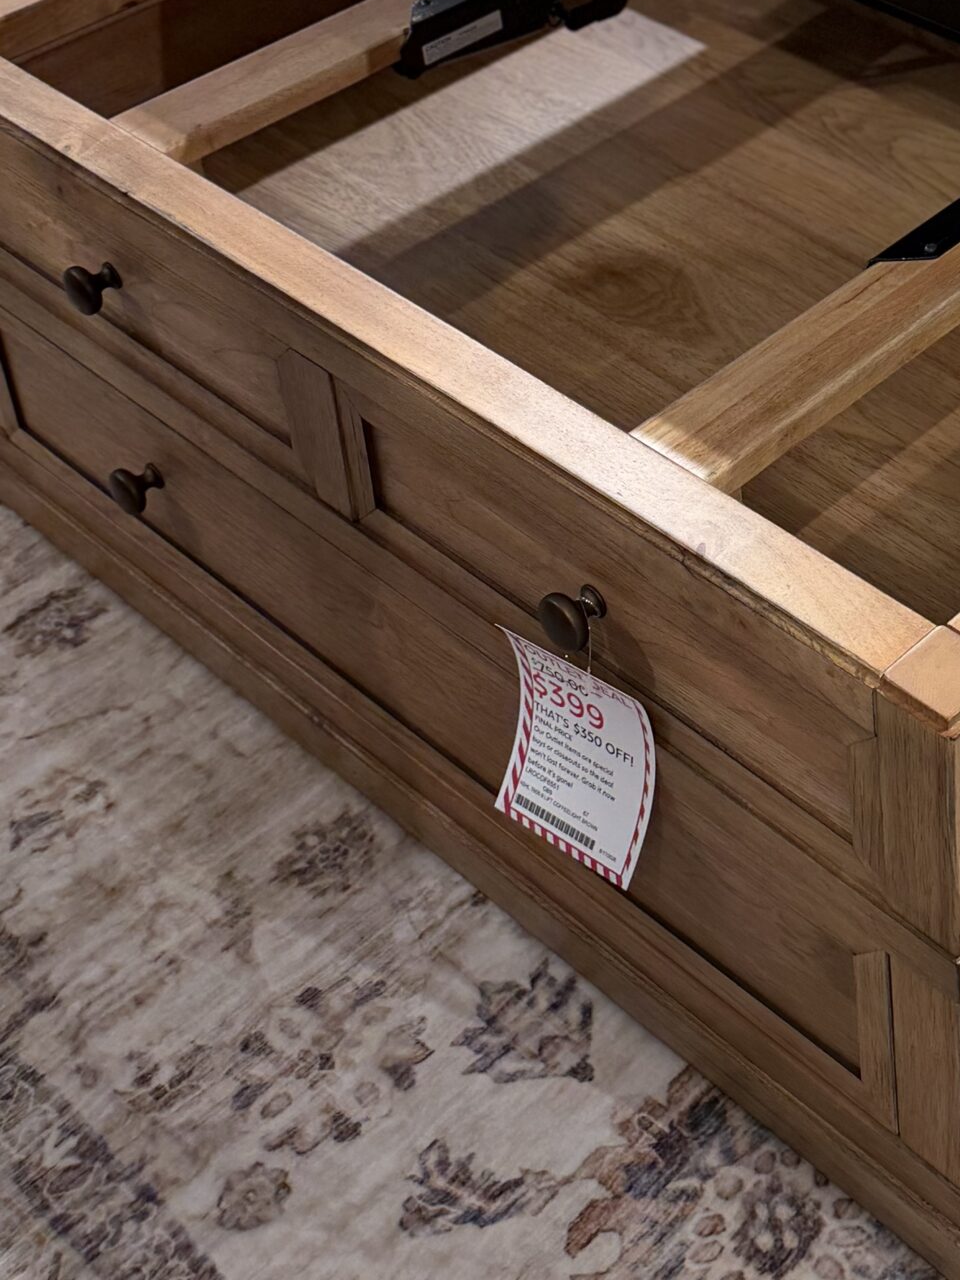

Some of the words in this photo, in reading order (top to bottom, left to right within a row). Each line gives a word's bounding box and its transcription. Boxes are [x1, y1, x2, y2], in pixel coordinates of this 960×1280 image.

[524, 644, 586, 680] OUTLET
[533, 672, 604, 730] $399
[534, 701, 569, 728] THAT'S
[574, 724, 602, 748] $350
[605, 742, 634, 767] OFF!
[534, 725, 545, 735] Our
[545, 731, 564, 747] Outlet
[581, 755, 592, 764] are
[593, 761, 614, 777] special
[535, 715, 553, 730] FINAL
[554, 726, 572, 741] PRICE
[528, 756, 547, 771] before
[547, 769, 556, 778] it's
[556, 775, 574, 789] gone!
[530, 747, 546, 760] won't
[546, 755, 558, 768] last
[581, 777, 597, 791] Grab
[597, 786, 602, 794] it
[602, 791, 616, 801] now
[532, 736, 546, 749] buys
[554, 749, 581, 769] closeouts
[581, 765, 589, 774] so
[589, 770, 599, 780] the
[600, 776, 614, 788] deal
